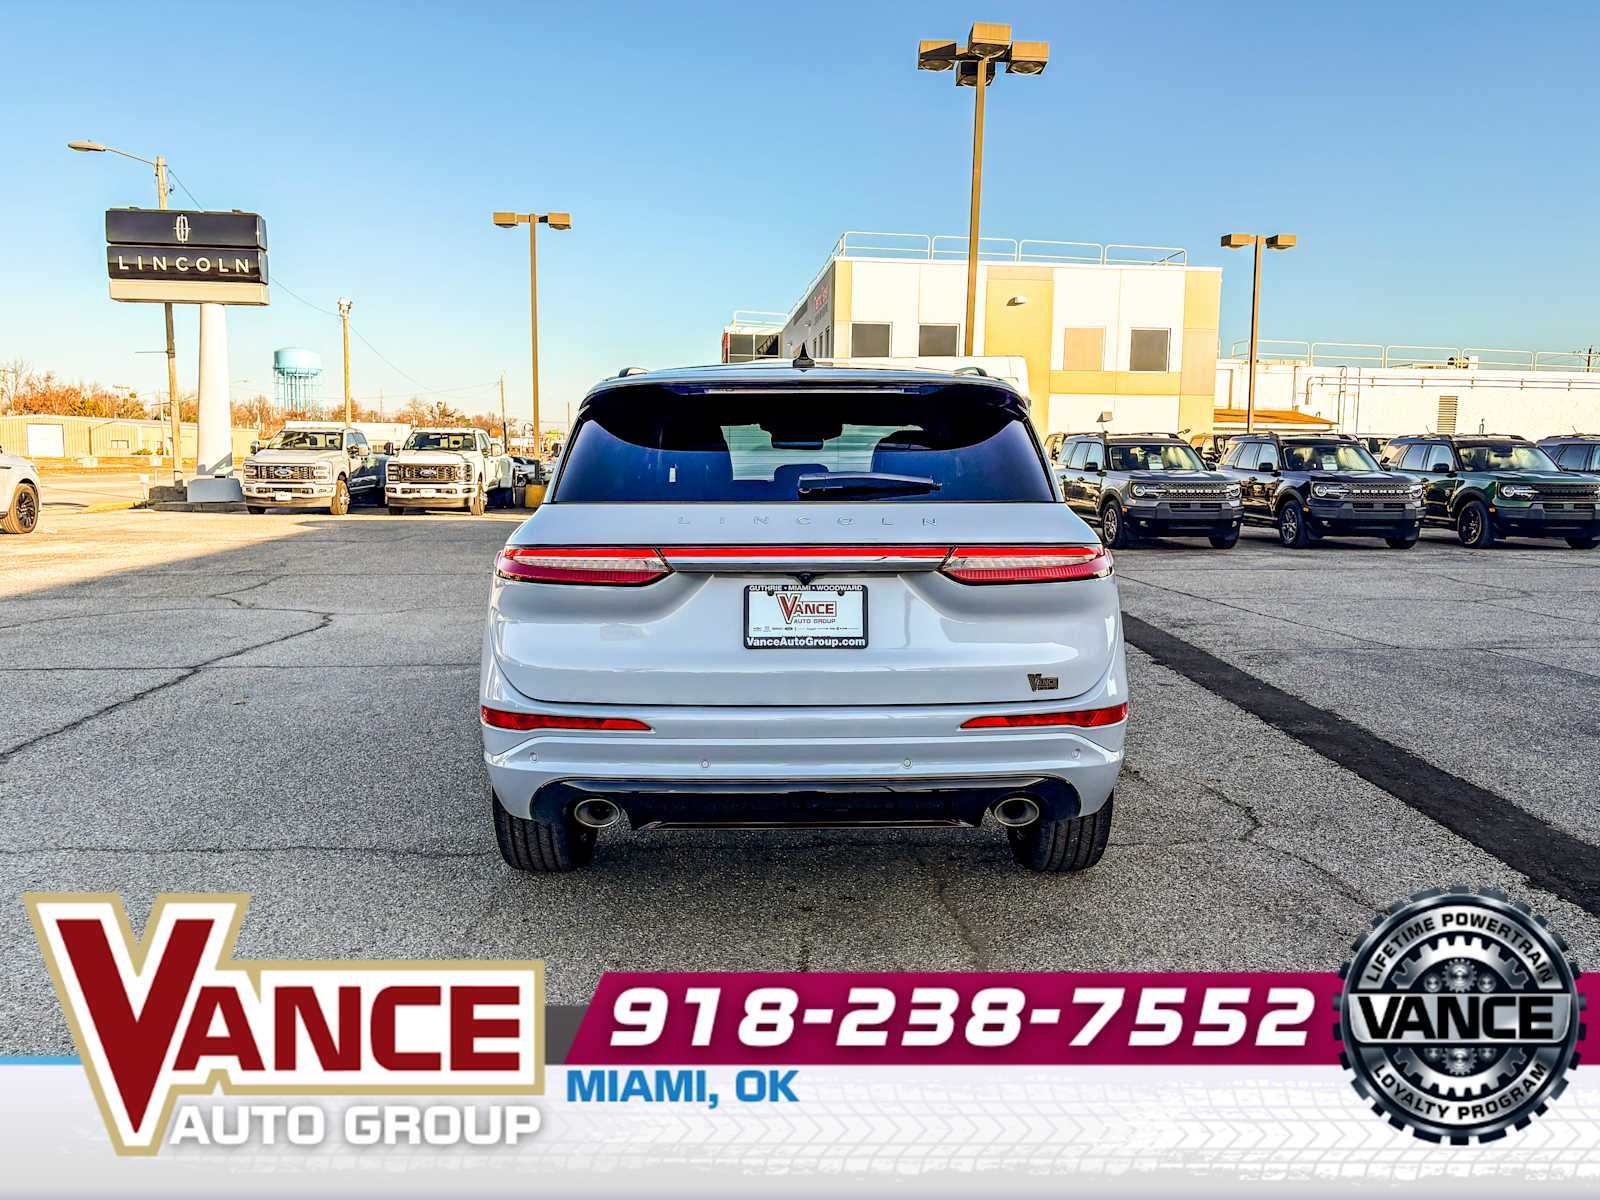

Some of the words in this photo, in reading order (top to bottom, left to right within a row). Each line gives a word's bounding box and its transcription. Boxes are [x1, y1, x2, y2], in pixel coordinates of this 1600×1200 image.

[118, 255, 249, 273] LINCOLN
[678, 516, 938, 527] LINCOLN
[779, 596, 834, 619] VANCE
[747, 637, 866, 647] VanceAutoGroup.com
